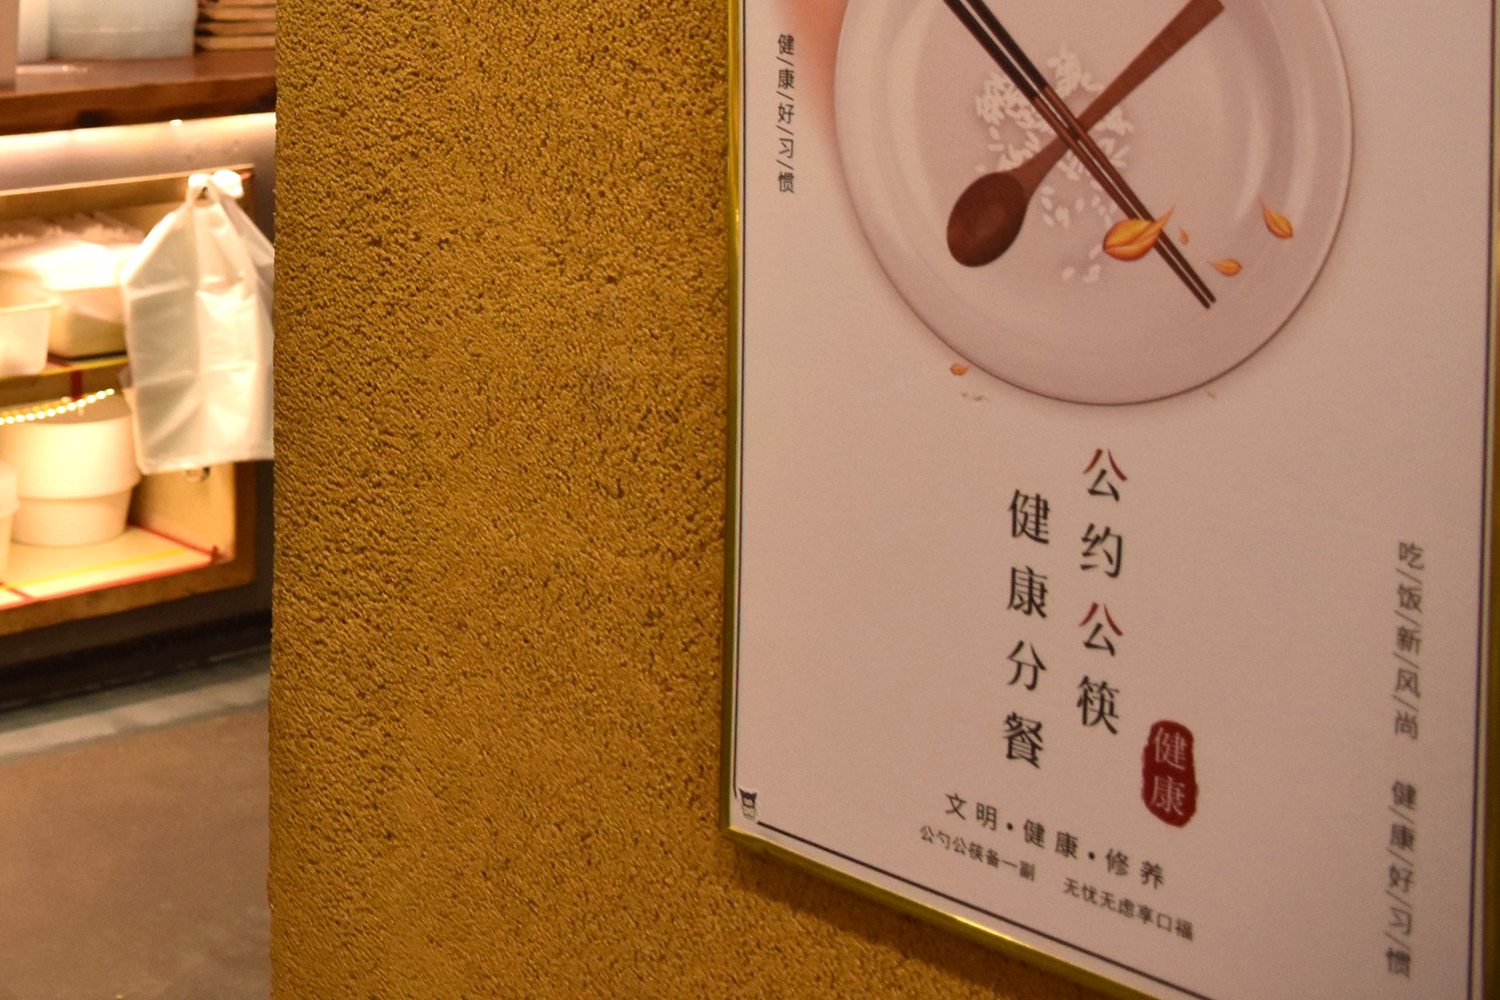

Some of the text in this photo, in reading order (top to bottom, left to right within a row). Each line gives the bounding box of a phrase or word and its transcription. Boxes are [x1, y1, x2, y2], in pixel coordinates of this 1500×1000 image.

[776, 34, 795, 194] 健/康/好/习/惯
[1003, 488, 1051, 769] 健康分餐
[1076, 448, 1128, 736] 公约公筷
[1150, 727, 1188, 818] 健康
[1385, 542, 1425, 978] 吃/饭/新/风/尚 健/康/好/习/惯
[920, 824, 1194, 941] 公勺公筷备一副 无忧无虑享口福
